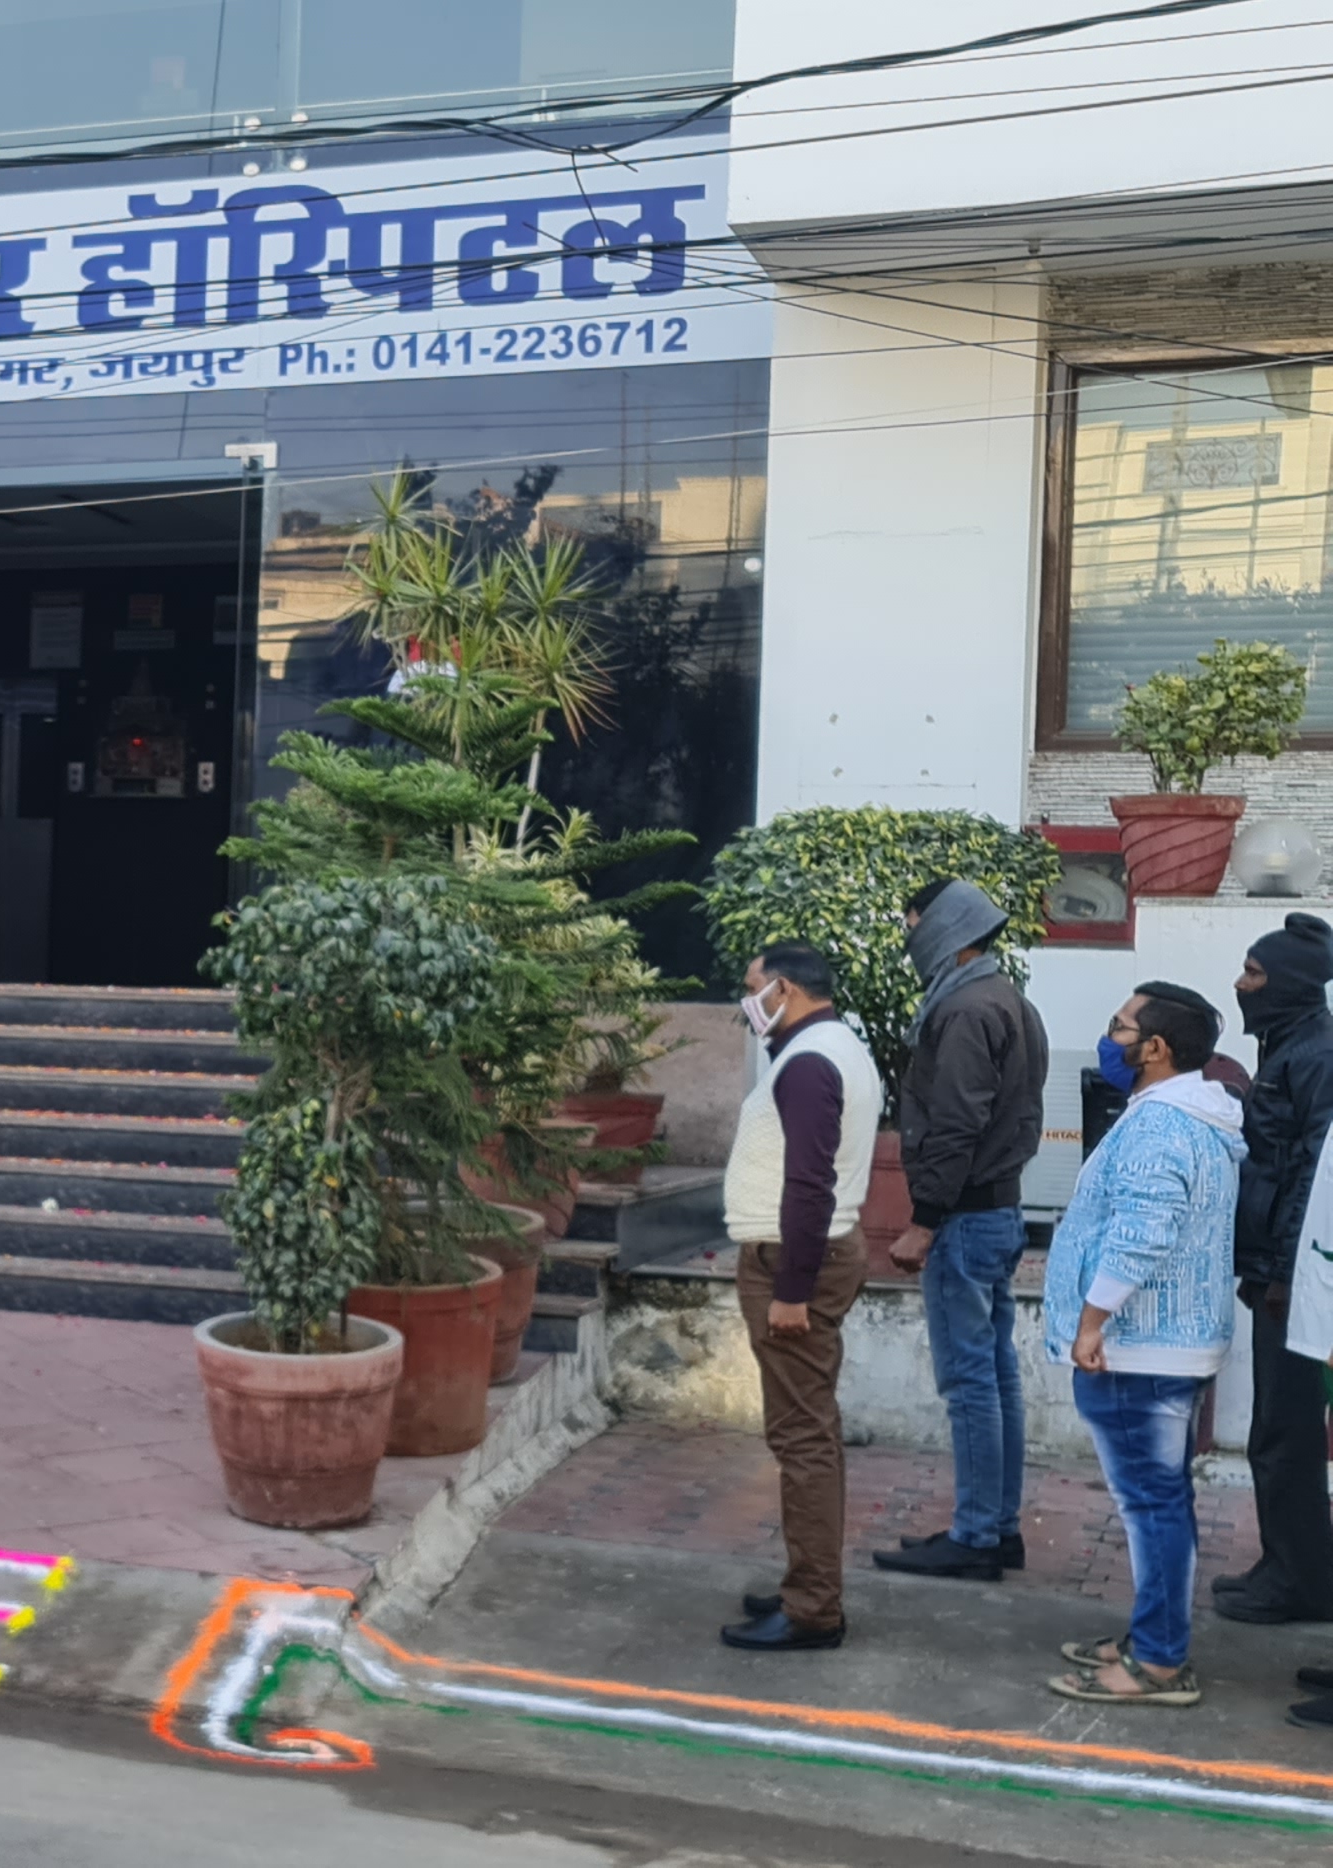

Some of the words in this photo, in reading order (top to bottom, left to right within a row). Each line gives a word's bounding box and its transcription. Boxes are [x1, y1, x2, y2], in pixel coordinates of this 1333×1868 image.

[71, 184, 707, 332] हॉस्पिटल
[88, 346, 252, 388] जयपुर
[278, 343, 356, 377] Ph.:
[371, 316, 690, 371] 0141-2236712
